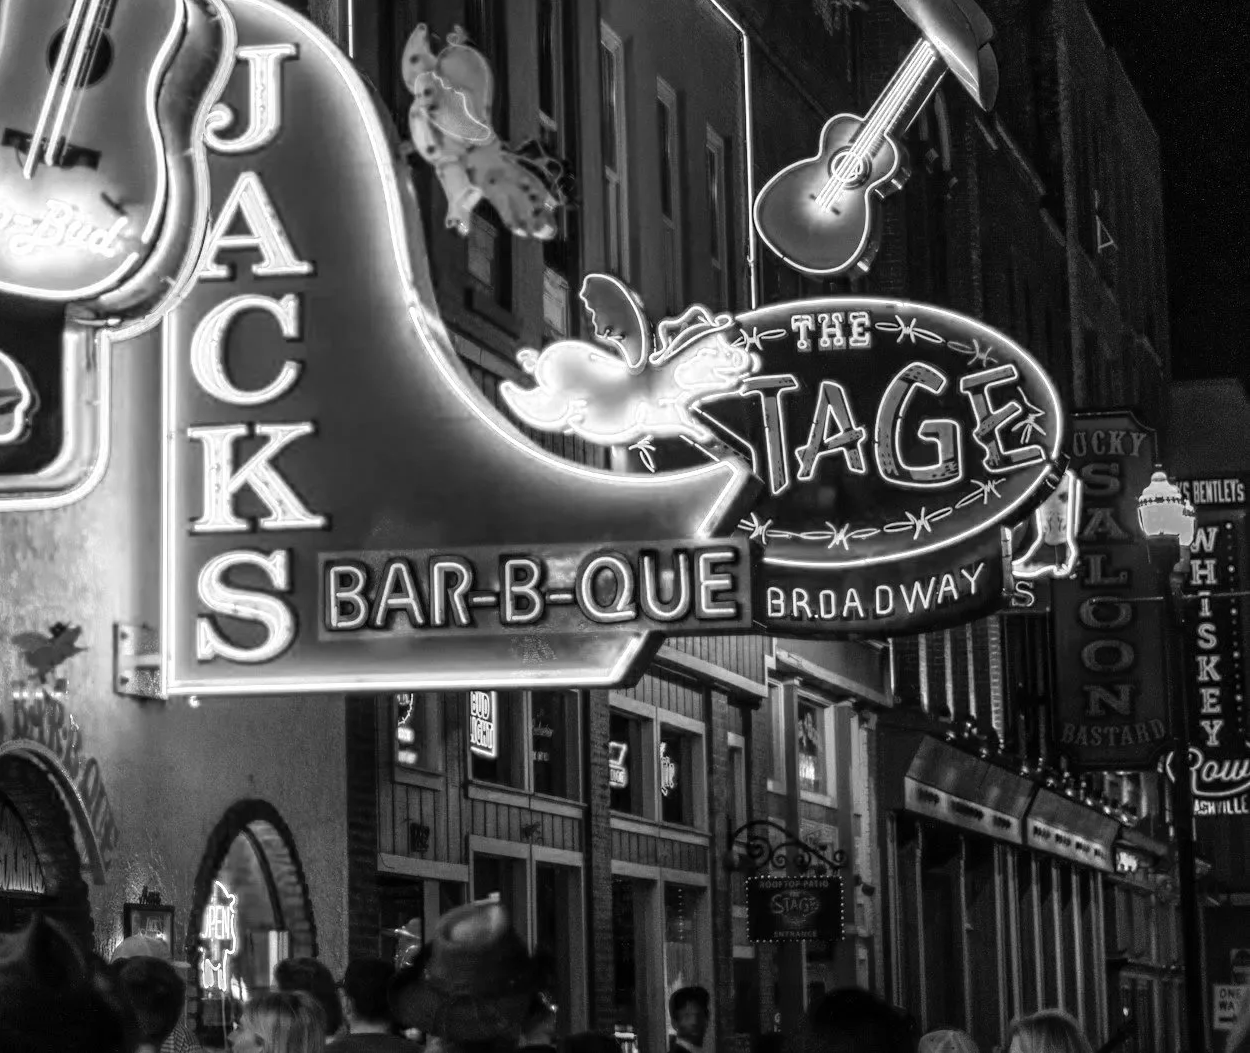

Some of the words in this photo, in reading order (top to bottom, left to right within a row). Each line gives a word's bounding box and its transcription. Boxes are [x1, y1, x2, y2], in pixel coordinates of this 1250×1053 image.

[187, 43, 328, 663] JACKS
[790, 312, 872, 350] THE
[695, 362, 1047, 496] TAGE
[1071, 430, 1147, 458] UCKY
[326, 550, 738, 629] BAR-B-QUE
[766, 562, 985, 620] BROADWAY
[1080, 462, 1136, 717] SALOON
[1189, 526, 1224, 747] WHISKEY
[1062, 717, 1167, 748] BASTARD
[1193, 793, 1249, 816] ASHVILLE
